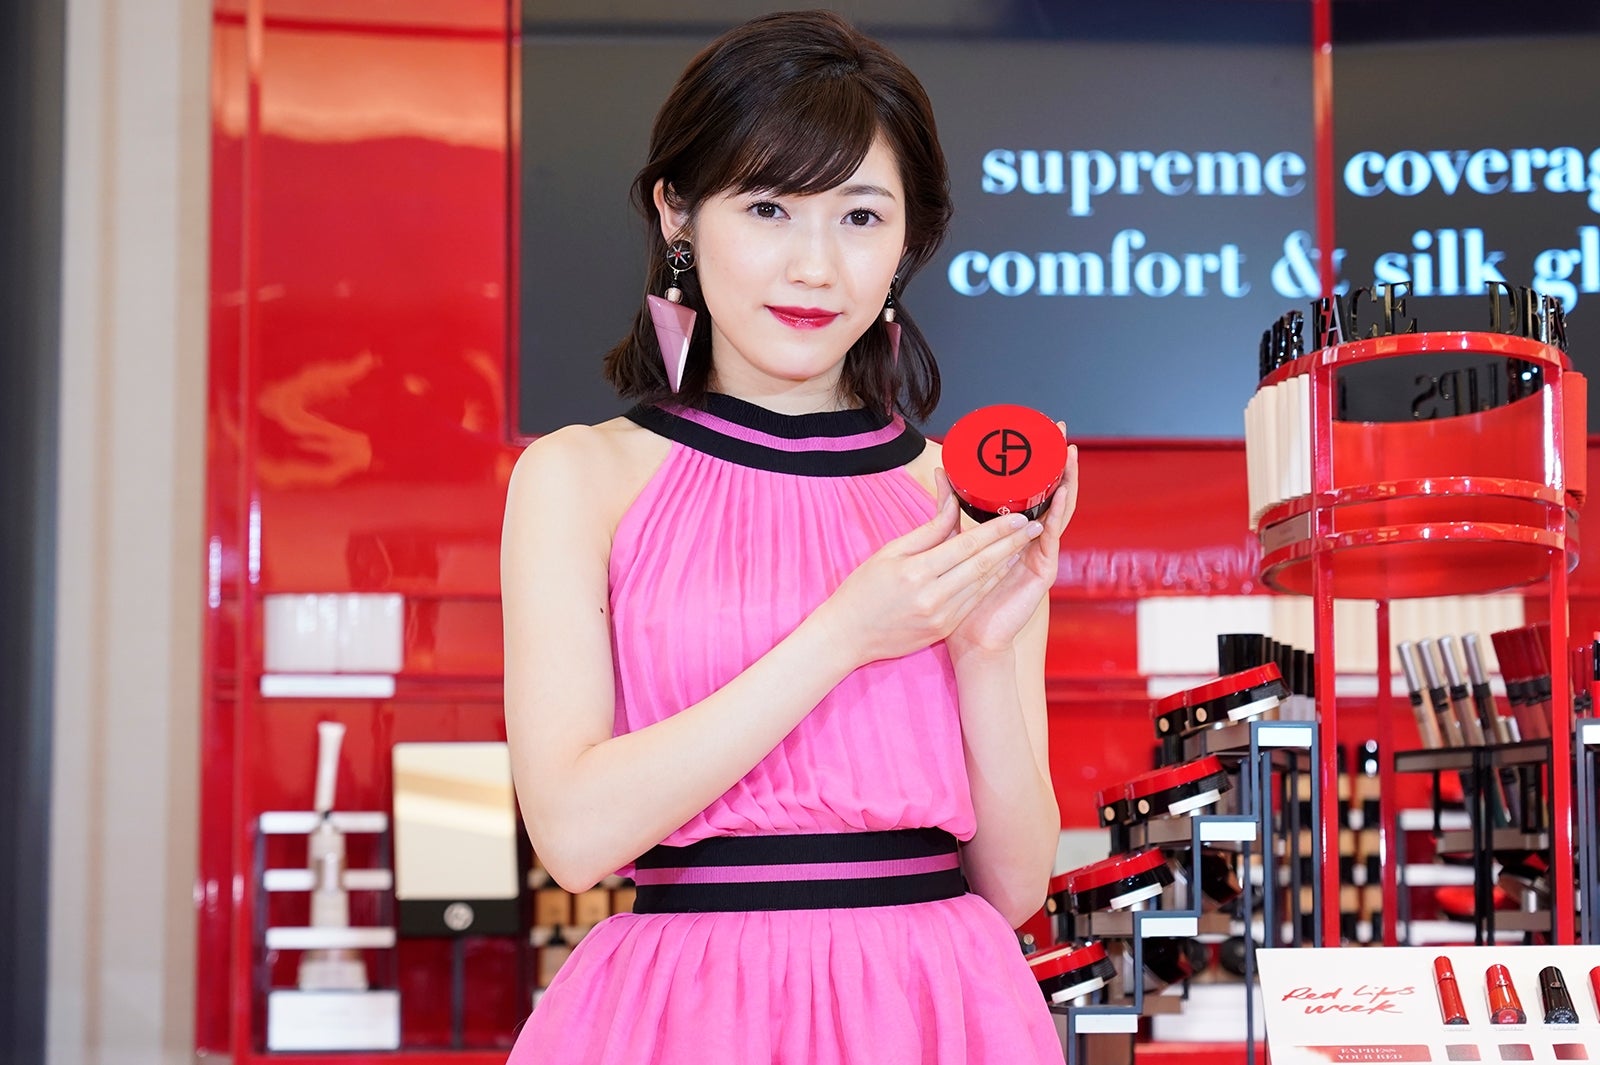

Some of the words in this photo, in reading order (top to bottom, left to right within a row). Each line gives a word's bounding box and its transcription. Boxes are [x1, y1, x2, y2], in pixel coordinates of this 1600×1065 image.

[982, 149, 1306, 216] supreme
[1343, 146, 1600, 214] covera
[948, 228, 1251, 298] comfort
[1271, 229, 1350, 298] &
[1373, 227, 1508, 296] silk
[1310, 281, 1417, 352] FACE
[1281, 987, 1343, 1002] Red
